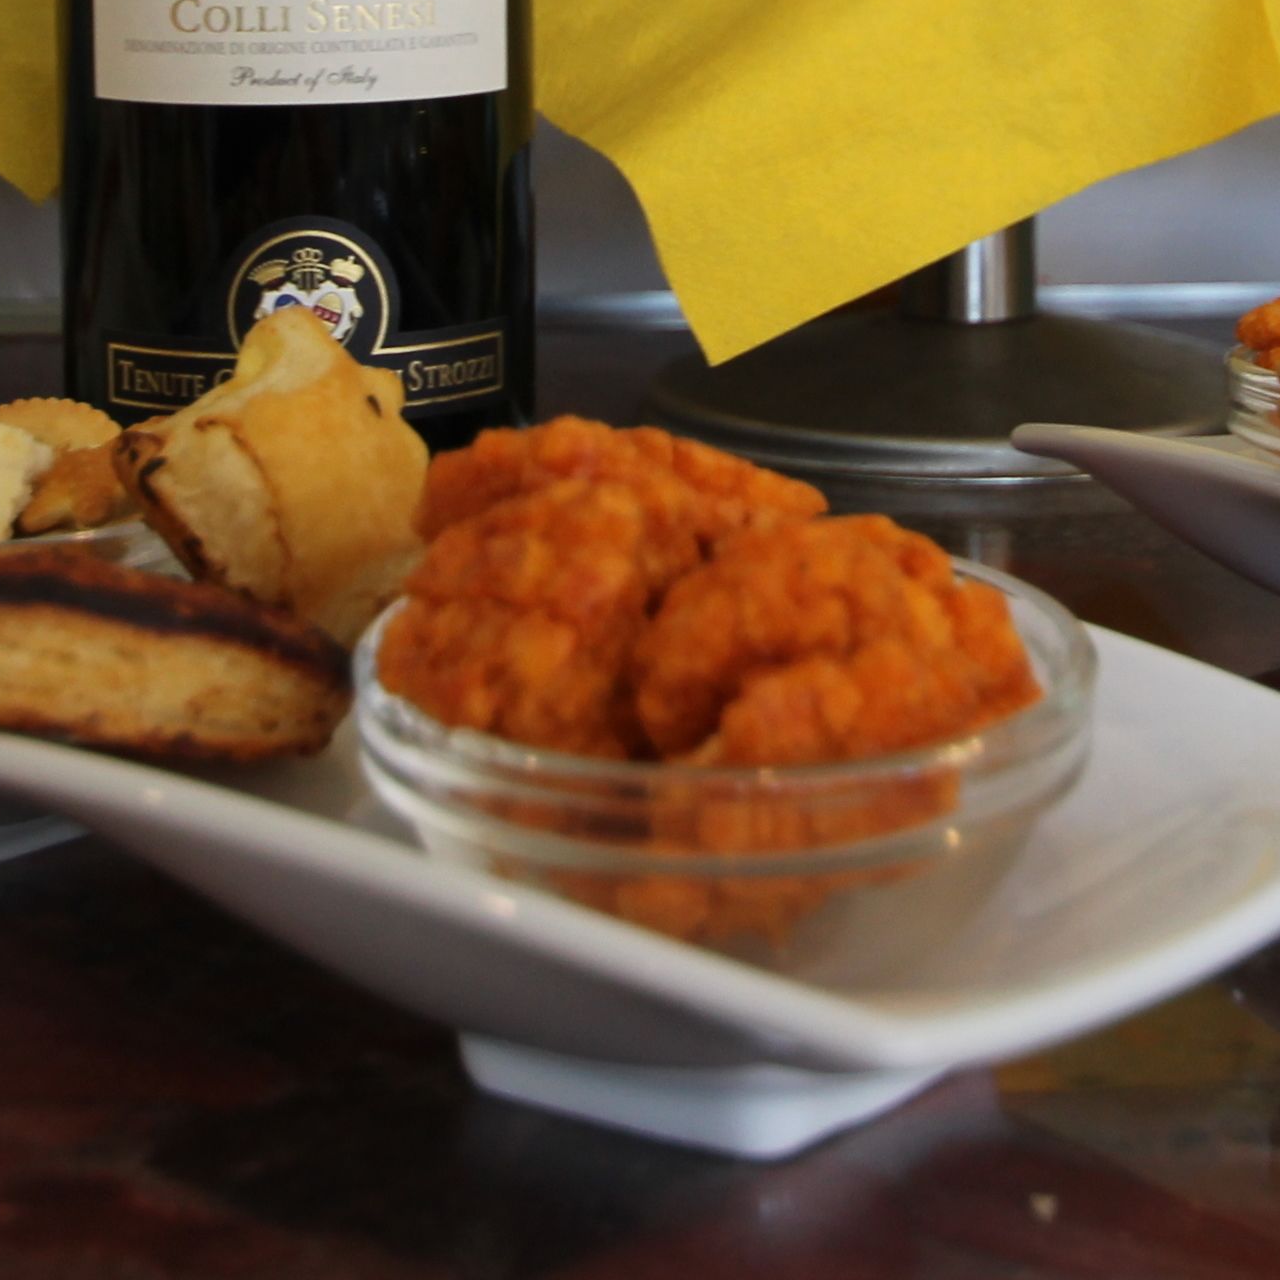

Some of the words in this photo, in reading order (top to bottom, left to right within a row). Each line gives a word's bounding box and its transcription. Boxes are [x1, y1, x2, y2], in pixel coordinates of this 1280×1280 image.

[229, 66, 302, 88] Product
[304, 67, 326, 94] of
[327, 64, 379, 92] Italy
[116, 358, 206, 397] TENUTE
[407, 355, 496, 392] STROZZI
